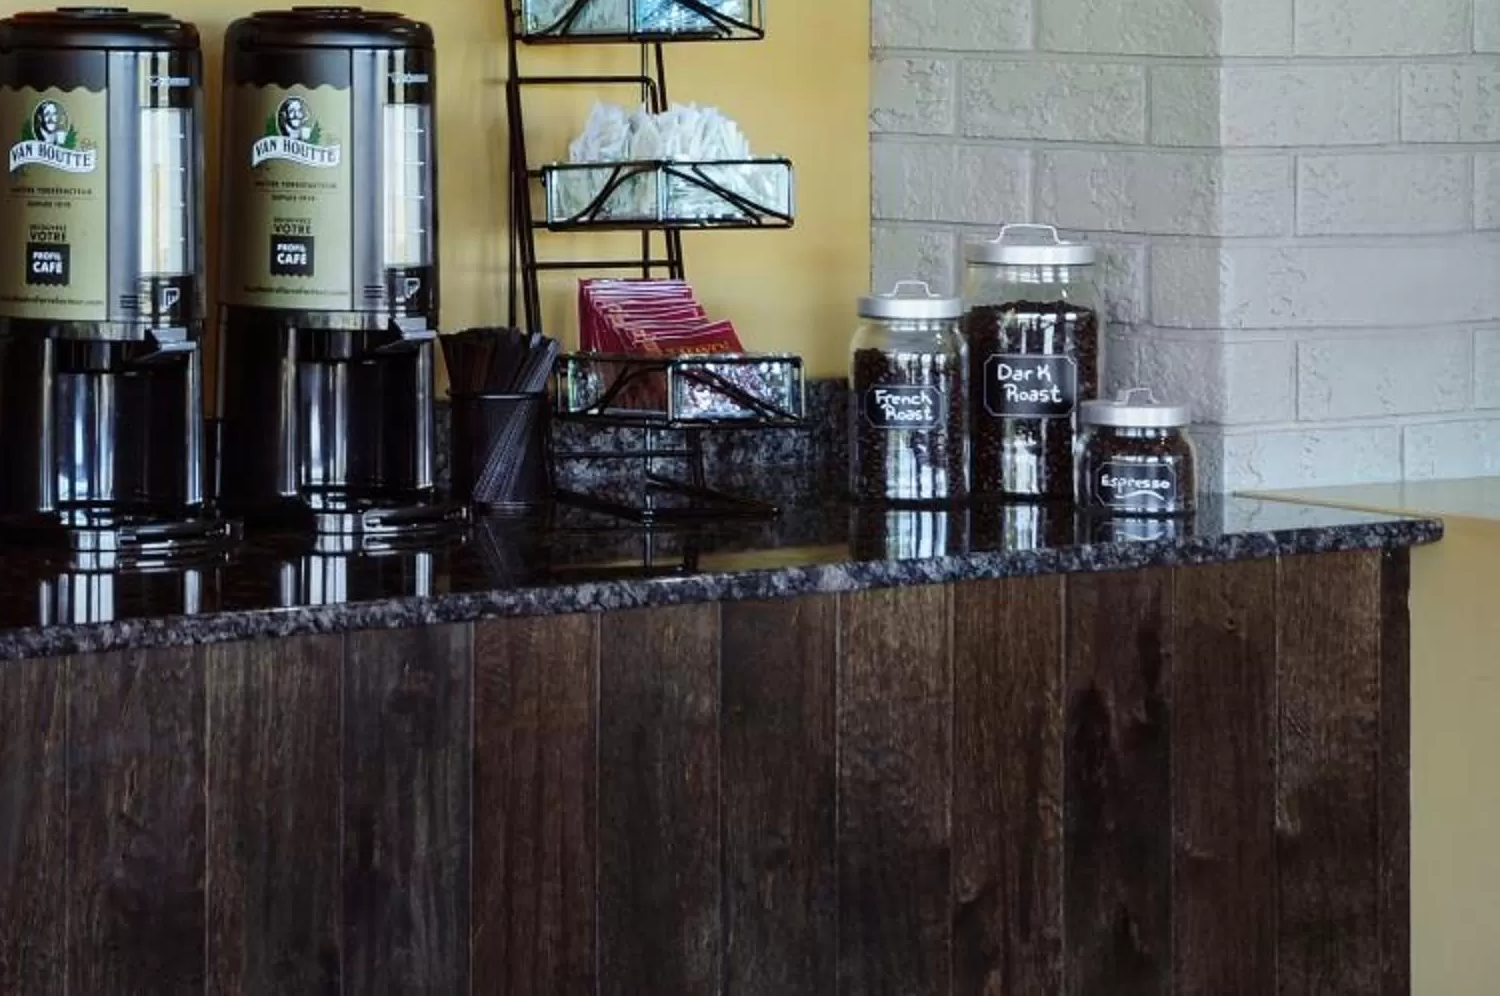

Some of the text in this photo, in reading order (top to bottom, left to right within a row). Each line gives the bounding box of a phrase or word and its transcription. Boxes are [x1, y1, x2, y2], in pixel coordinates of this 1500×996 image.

[12, 143, 92, 167] VAN HOUTTE
[256, 139, 336, 163] VAN HOUTTE
[875, 389, 933, 405] French
[1003, 383, 1063, 403] Roast
[880, 404, 933, 421] Roast
[1101, 474, 1171, 493] Espresso
